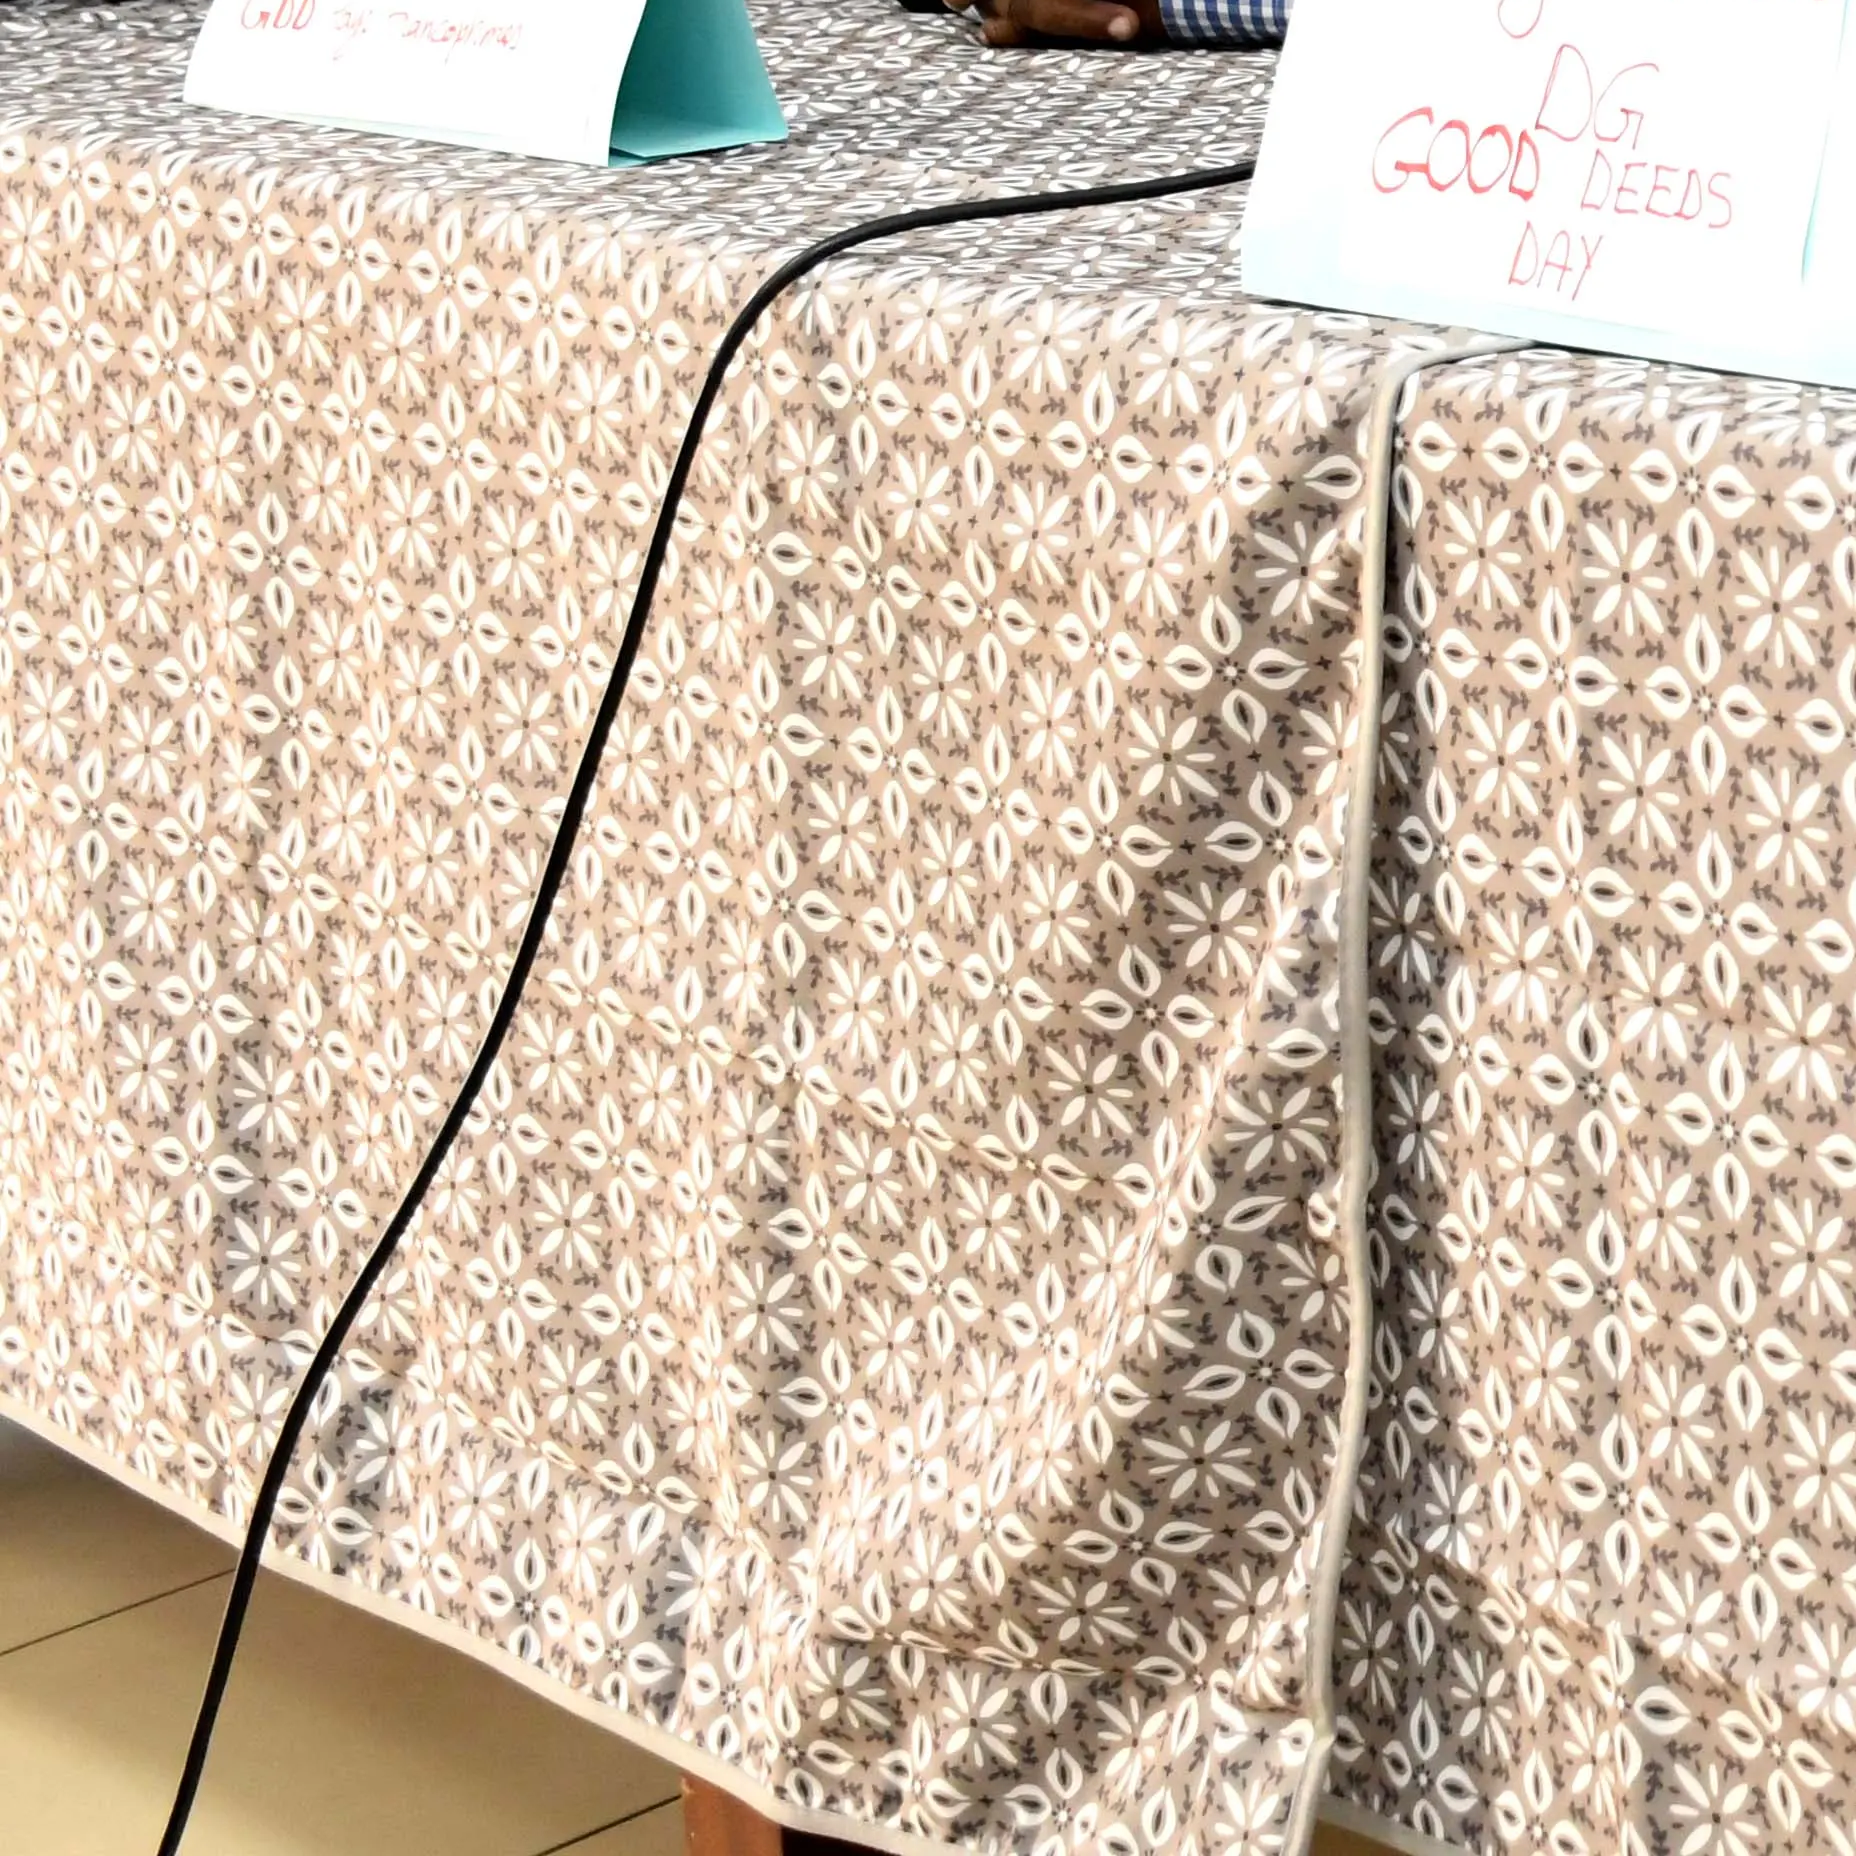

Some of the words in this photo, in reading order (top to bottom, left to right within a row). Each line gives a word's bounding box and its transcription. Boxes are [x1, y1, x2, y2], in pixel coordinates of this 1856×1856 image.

[1535, 44, 1660, 150] DG
[1371, 107, 1540, 202] GOOD
[1580, 149, 1735, 231] DEEDS
[1508, 219, 1604, 302] DAY
